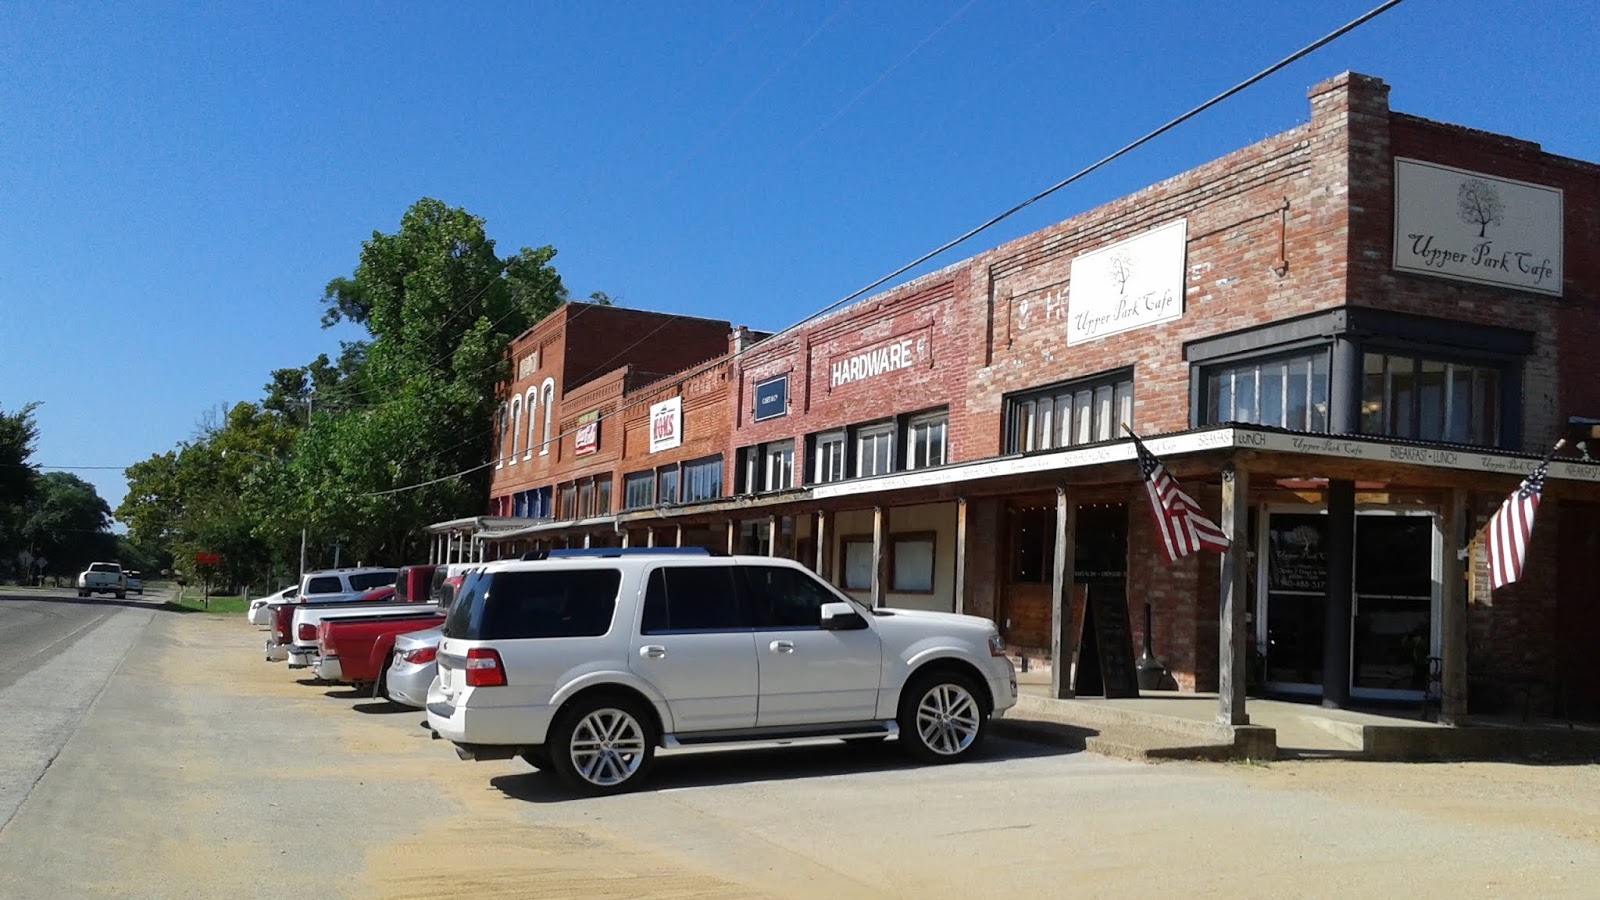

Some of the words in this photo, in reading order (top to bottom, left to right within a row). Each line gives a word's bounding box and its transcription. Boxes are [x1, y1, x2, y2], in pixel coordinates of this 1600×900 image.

[1408, 233, 1467, 267] Upper
[1471, 241, 1510, 272] Park
[1514, 252, 1553, 284] Cafe
[1075, 310, 1110, 335] Upper
[1113, 294, 1140, 321] Park
[1142, 289, 1173, 317] Cafe
[832, 339, 913, 387] HARDWARE
[1238, 432, 1266, 446] LUNCH
[1292, 437, 1320, 452] Upper
[1390, 446, 1428, 462] BREAKFAST
[1433, 451, 1458, 465] LUNCH
